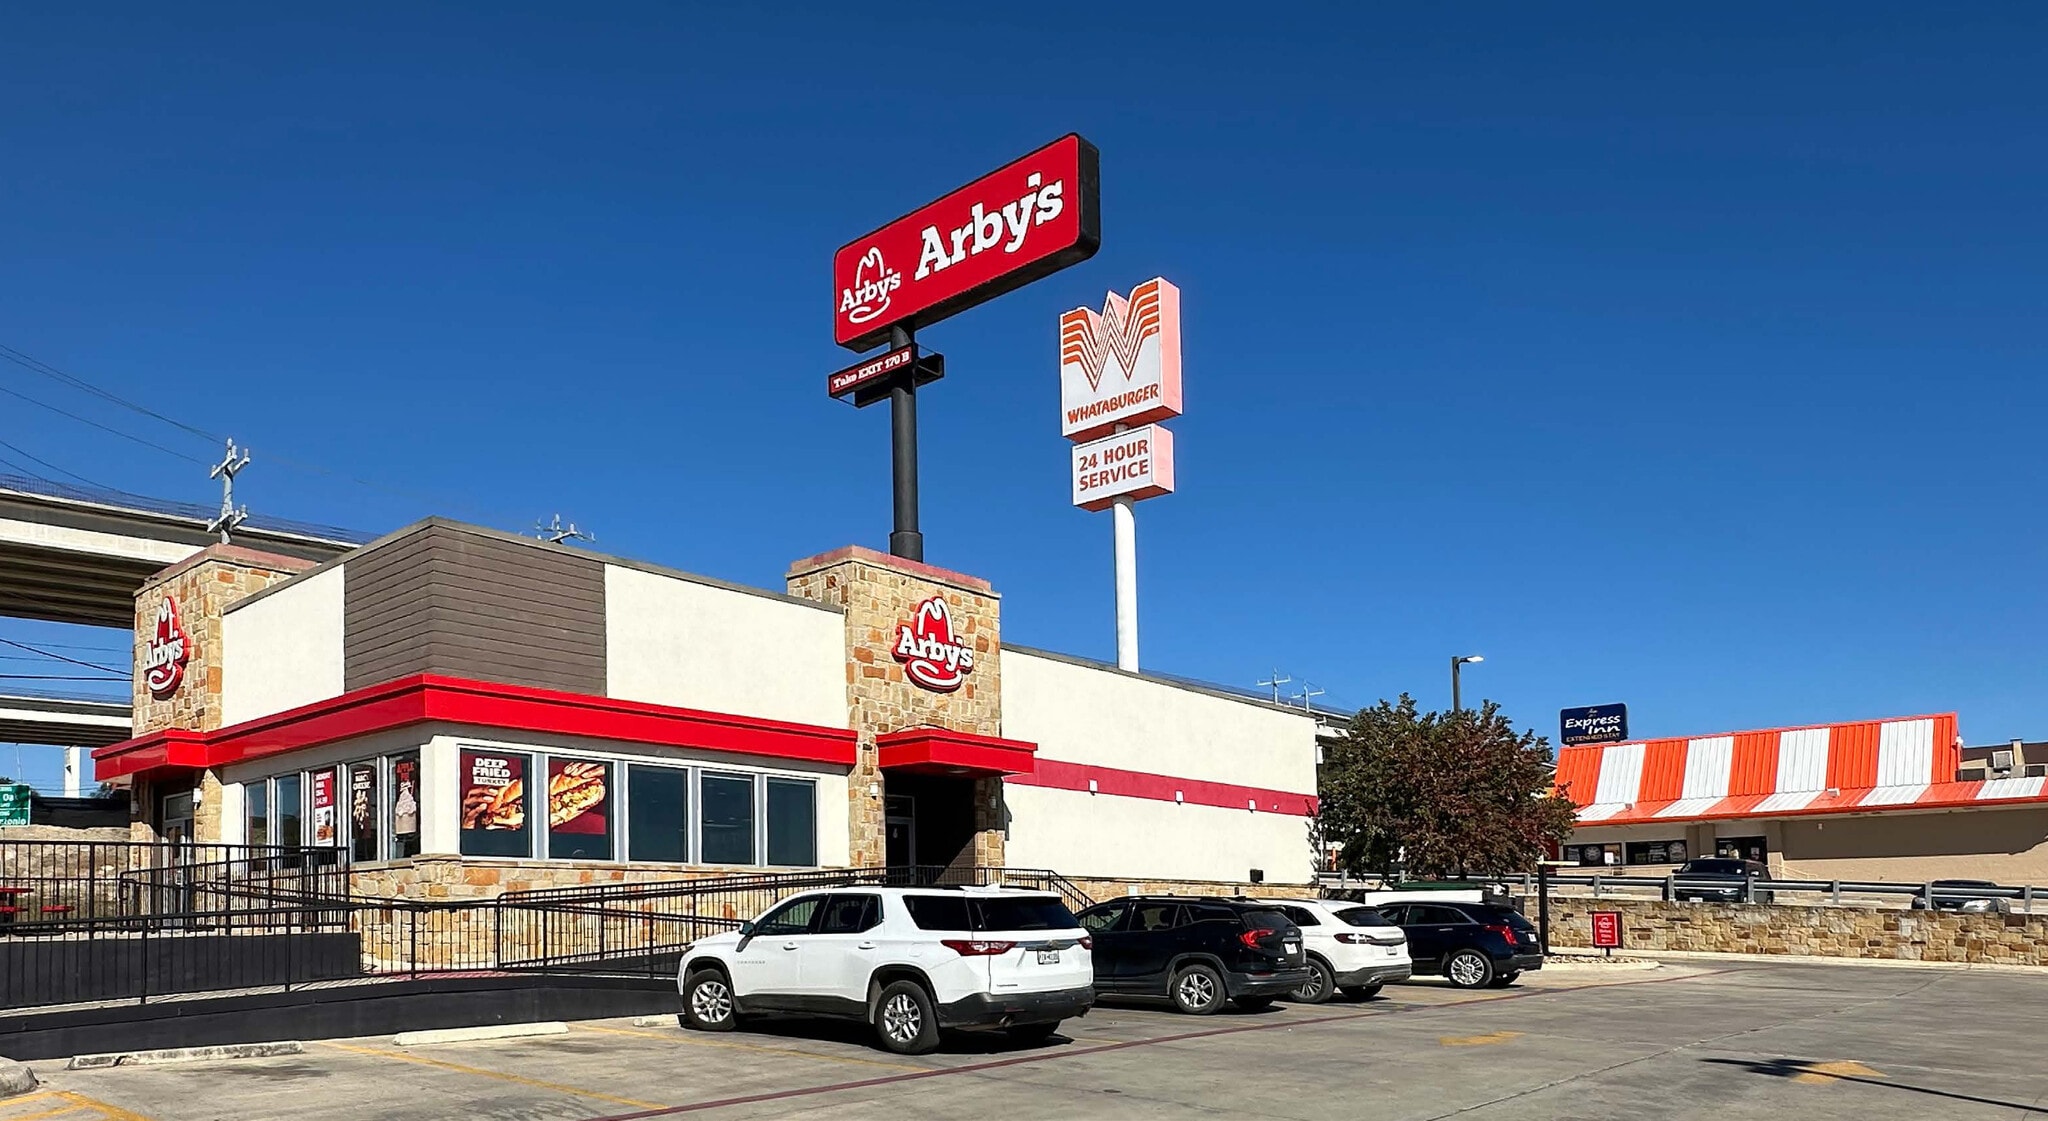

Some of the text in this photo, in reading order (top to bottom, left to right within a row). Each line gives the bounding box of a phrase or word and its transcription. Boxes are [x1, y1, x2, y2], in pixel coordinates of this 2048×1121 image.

[914, 171, 1064, 282] Arby's
[839, 267, 901, 313] Arby's
[833, 351, 910, 389] Take EXIT 170 B
[1067, 383, 1160, 425] WHATABURGER
[1078, 439, 1149, 472] 24 HOUR
[1079, 458, 1150, 491] SERVICE
[143, 629, 184, 671] Arby's
[898, 626, 974, 672] Arby's
[1565, 715, 1621, 731] Express
[1588, 725, 1621, 735] Inn
[472, 766, 511, 778] FRIED
[475, 757, 509, 769] DEEP
